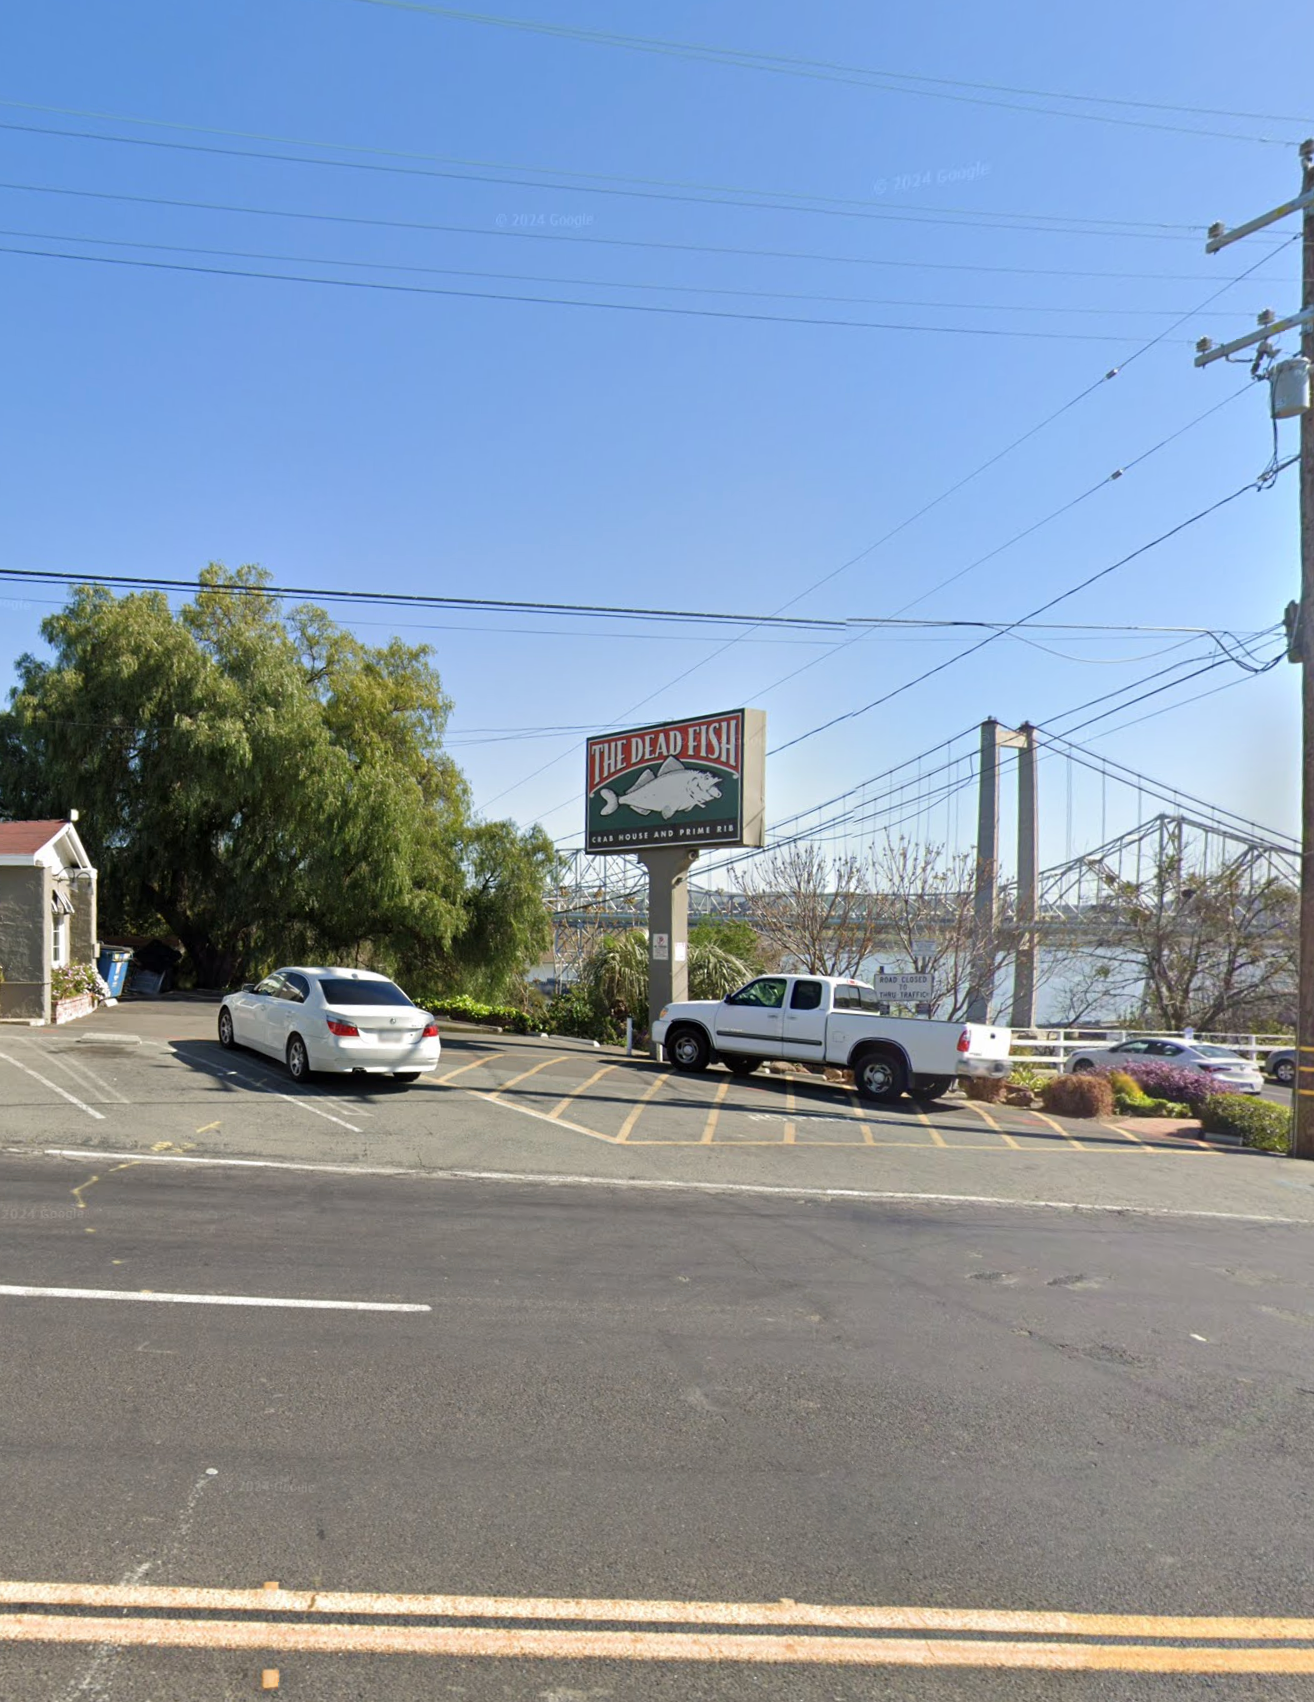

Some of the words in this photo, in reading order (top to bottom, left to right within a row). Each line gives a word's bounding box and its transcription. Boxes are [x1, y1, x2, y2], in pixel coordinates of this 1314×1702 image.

[591, 739, 627, 785] THE
[630, 729, 682, 764] DEAD
[687, 719, 738, 766] FISH
[591, 835, 614, 843] CRAB
[618, 832, 648, 841] HOUSE
[653, 830, 674, 838] AND
[679, 826, 711, 836] PRIME
[716, 824, 734, 832] RIB
[879, 991, 896, 999] THRU
[900, 991, 928, 999] TRAFFIC
